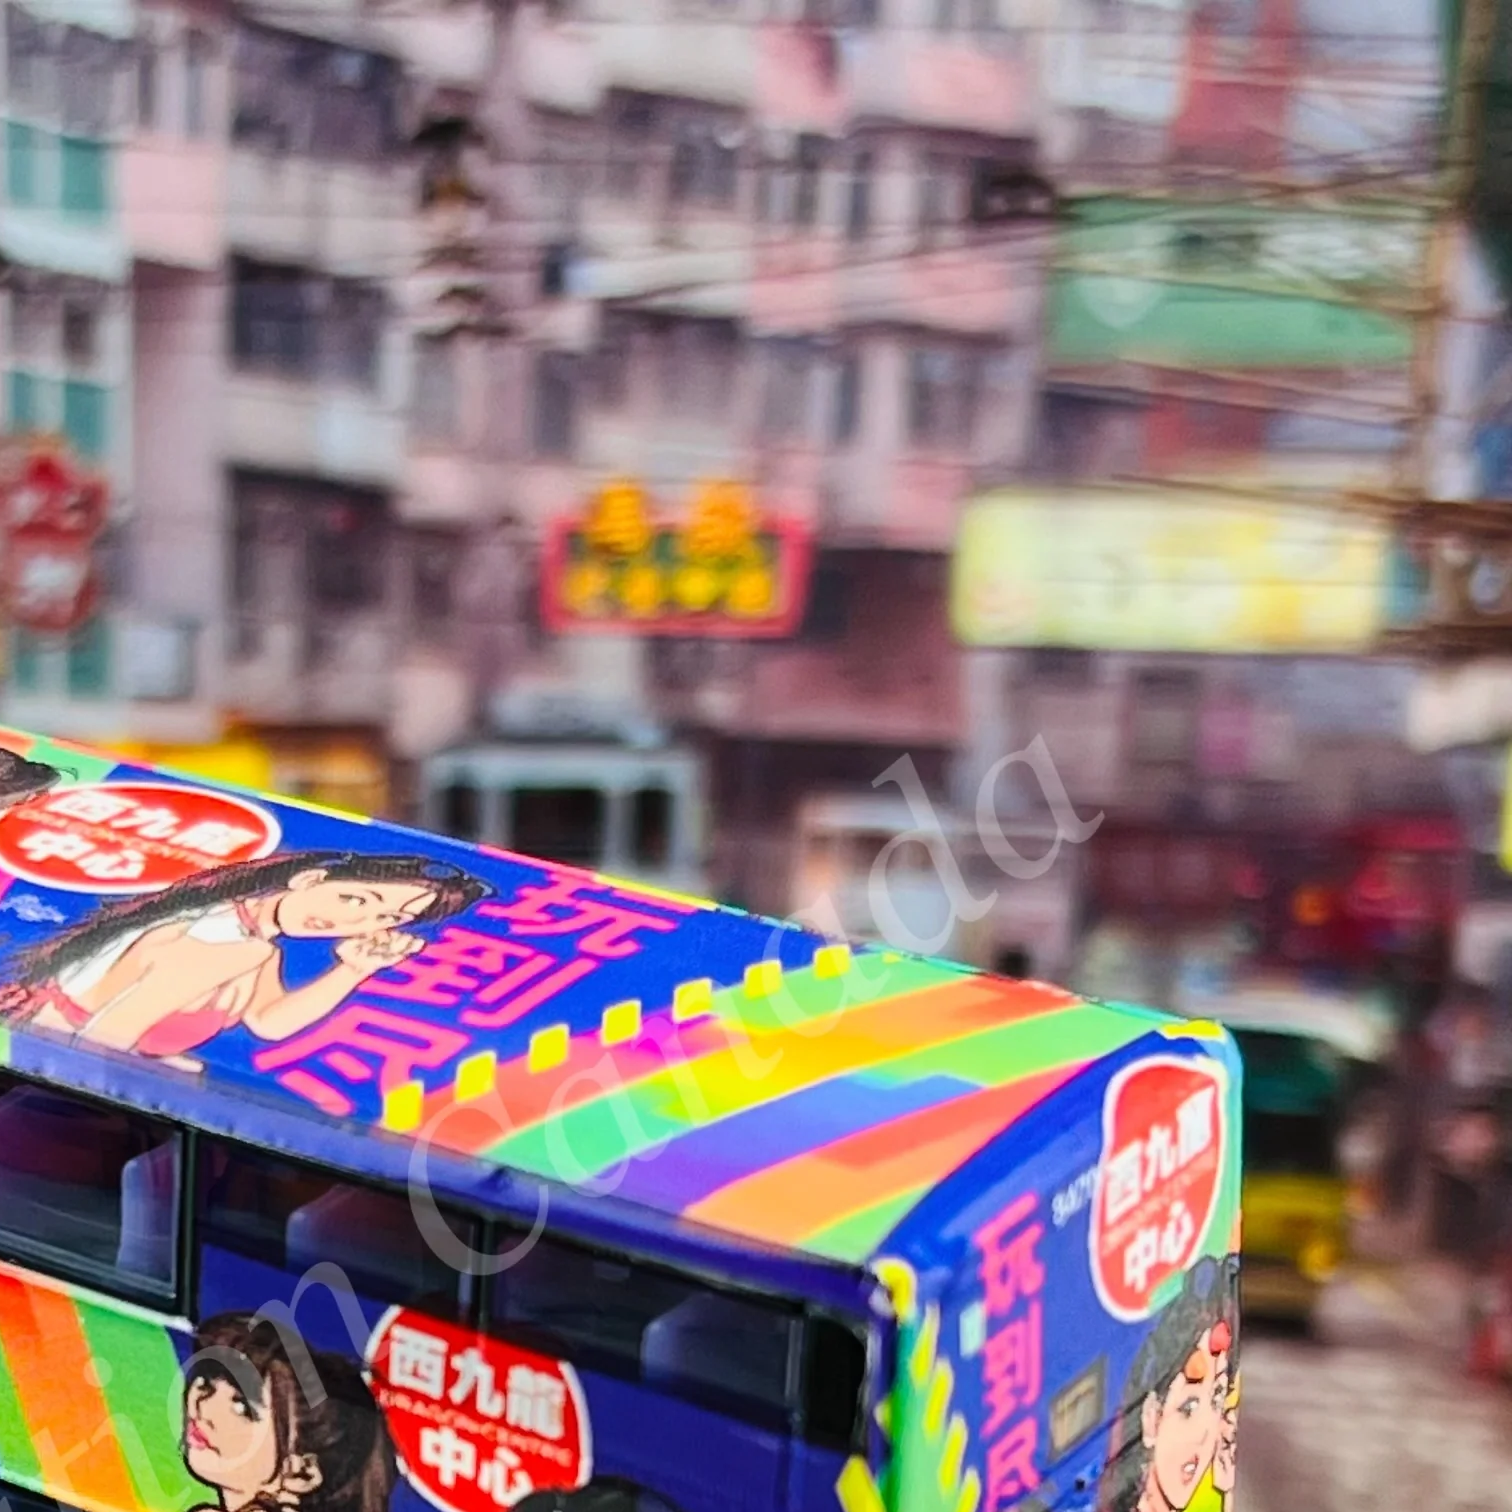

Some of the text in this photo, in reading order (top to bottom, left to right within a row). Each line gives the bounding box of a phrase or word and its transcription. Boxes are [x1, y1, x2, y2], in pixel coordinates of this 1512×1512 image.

[17, 830, 147, 879] 中心
[1122, 1201, 1195, 1294] 中心
[388, 1322, 567, 1441] 西九龍
[418, 1425, 535, 1508] 中心
